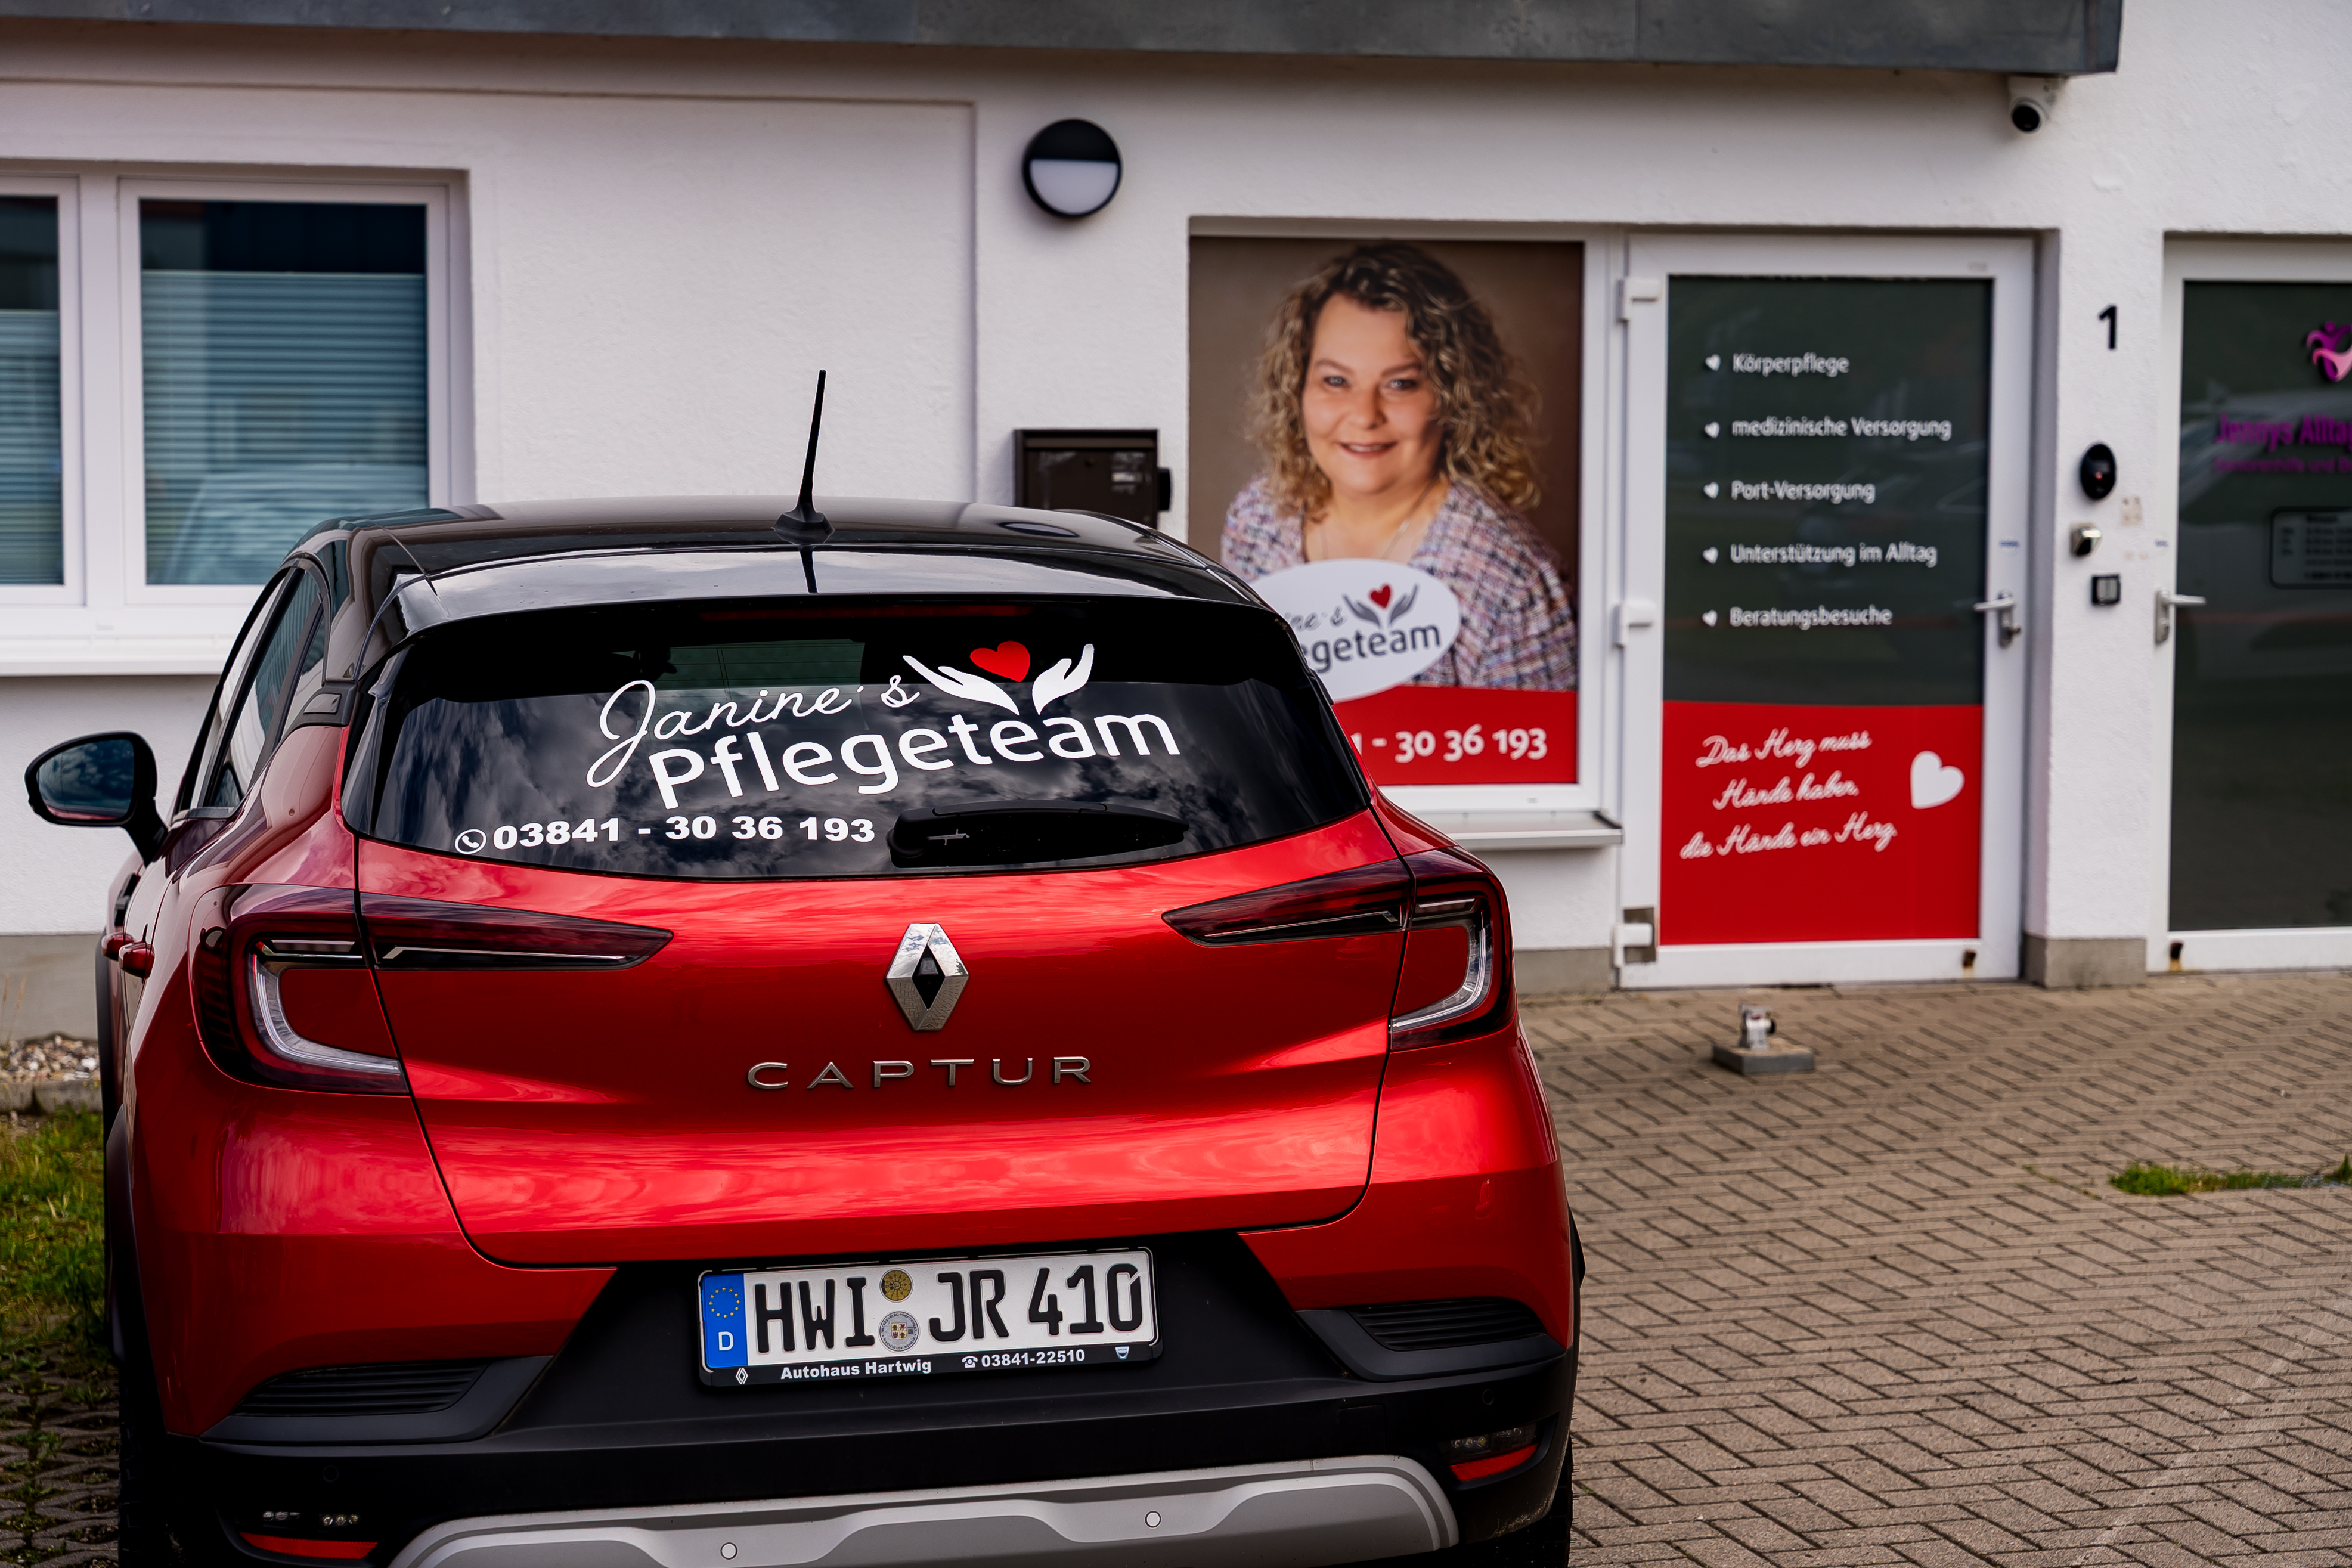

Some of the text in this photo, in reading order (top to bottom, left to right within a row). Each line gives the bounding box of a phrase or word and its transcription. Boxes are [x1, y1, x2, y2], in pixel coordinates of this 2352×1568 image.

[2099, 305, 2117, 349] 1
[1733, 352, 1849, 377] Körperpflege
[1731, 416, 1952, 441] medizinische Versorgung
[2214, 413, 2292, 452] Jennys
[1731, 480, 1876, 504] Port-Versorgung
[1730, 541, 1937, 568] Unterstützung im Alltag
[1730, 604, 1893, 630] Beratungsbesuche
[1300, 626, 1440, 674] geteam
[1394, 730, 1436, 764] 30
[1443, 723, 1485, 762] 36
[1492, 727, 1548, 760] 193
[1695, 735, 1752, 768] Das
[1818, 730, 1873, 752] muss
[648, 712, 1182, 811] Pflegeteam
[1712, 776, 1793, 810] Hände
[493, 817, 619, 849] 03841
[665, 816, 717, 839] 30
[732, 816, 783, 839] 36
[798, 817, 875, 842] 193
[1680, 831, 1714, 859] die
[1716, 822, 1798, 856] Hände
[1799, 827, 1832, 847] ein
[747, 1056, 1092, 1089] CAPTUR
[754, 1277, 875, 1353] HWI
[929, 1270, 1009, 1342] JR
[1028, 1263, 1143, 1337] 410
[717, 1331, 733, 1350] D
[780, 1359, 932, 1380] Autohaus Hartwig
[981, 1349, 1085, 1368] 03841-22510
